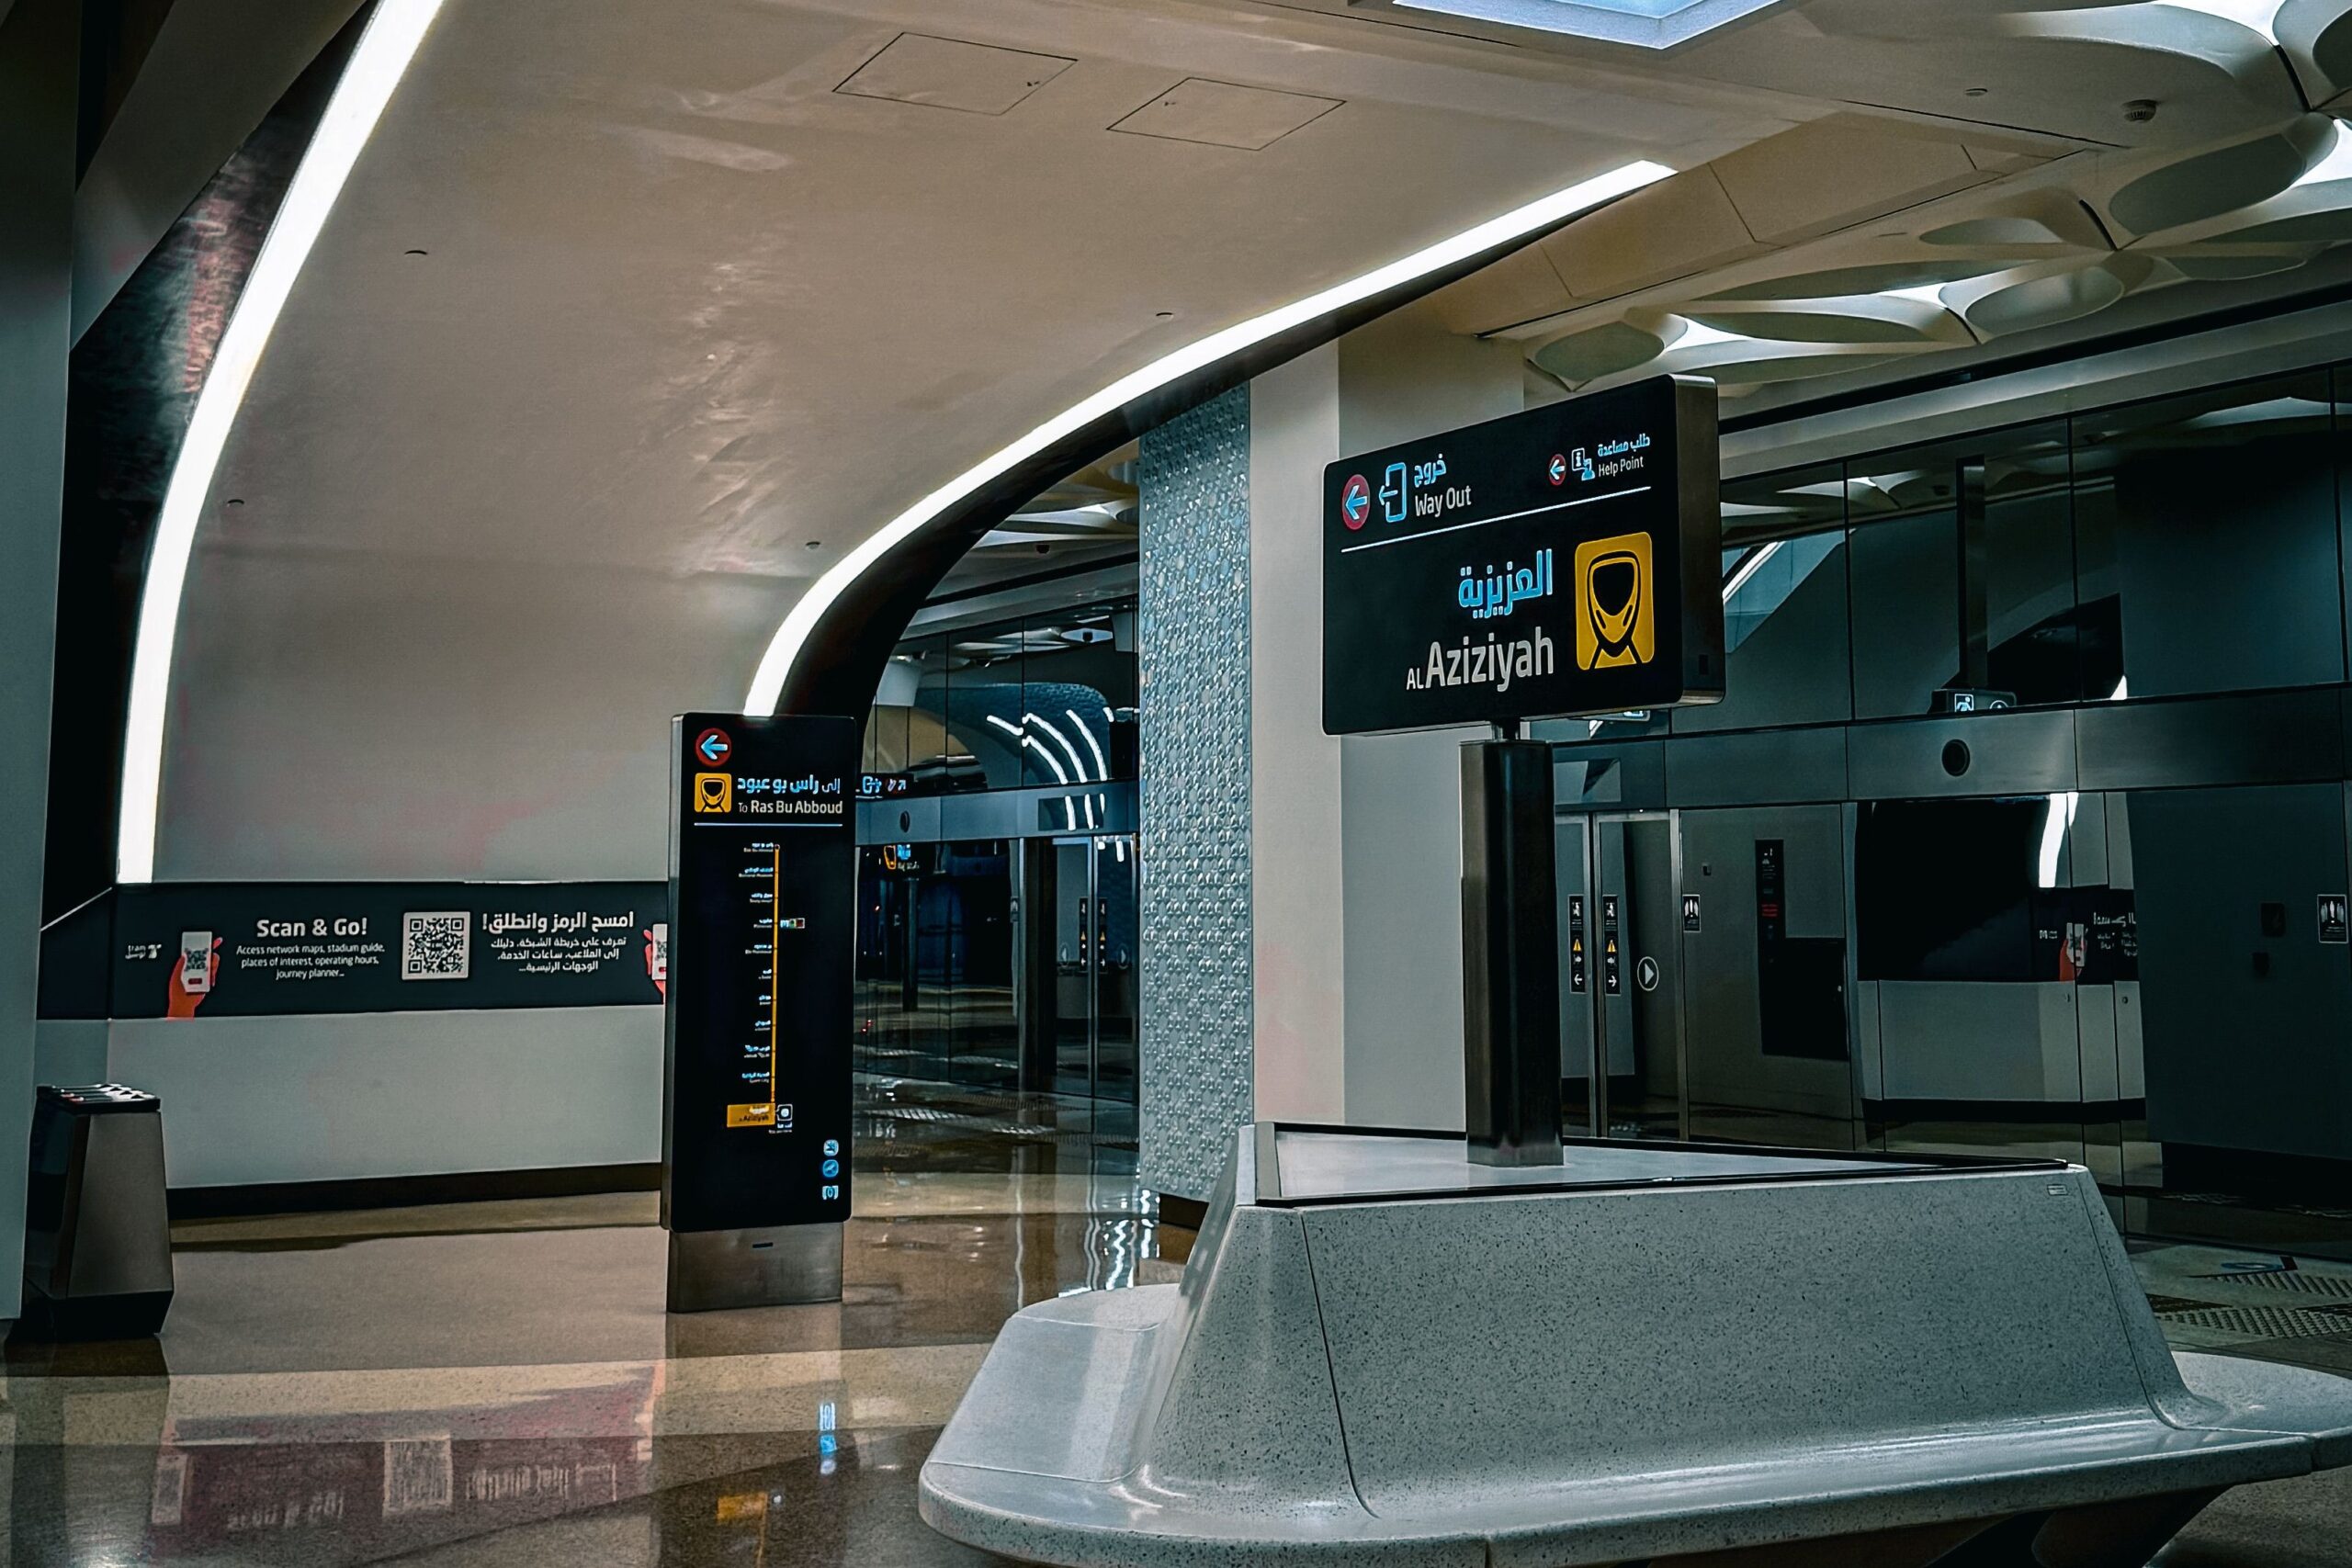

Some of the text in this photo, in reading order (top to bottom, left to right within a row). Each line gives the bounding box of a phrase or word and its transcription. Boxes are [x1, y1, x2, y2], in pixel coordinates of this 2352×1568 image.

[1598, 433, 1650, 457] طلب مساعدة
[1413, 453, 1447, 488] خروج
[1599, 456, 1644, 477] Help Point
[1414, 484, 1472, 518] Way Out
[1458, 548, 1553, 619] العزيزية
[1425, 626, 1554, 693] Aziziyah
[737, 777, 770, 795] عبود
[773, 778, 787, 795] بو
[821, 777, 841, 795] إلى
[738, 799, 843, 814] To Ras Bu Abboud
[256, 917, 368, 938] Scan & Go!
[482, 910, 634, 934] امسح الرمز وانطلق!
[236, 945, 266, 955] Access
[266, 944, 300, 954] network
[327, 943, 359, 953] stadium
[582, 936, 599, 948] على
[241, 957, 267, 969] places
[269, 957, 278, 966] of
[314, 955, 353, 967] operating
[276, 969, 308, 981] journey
